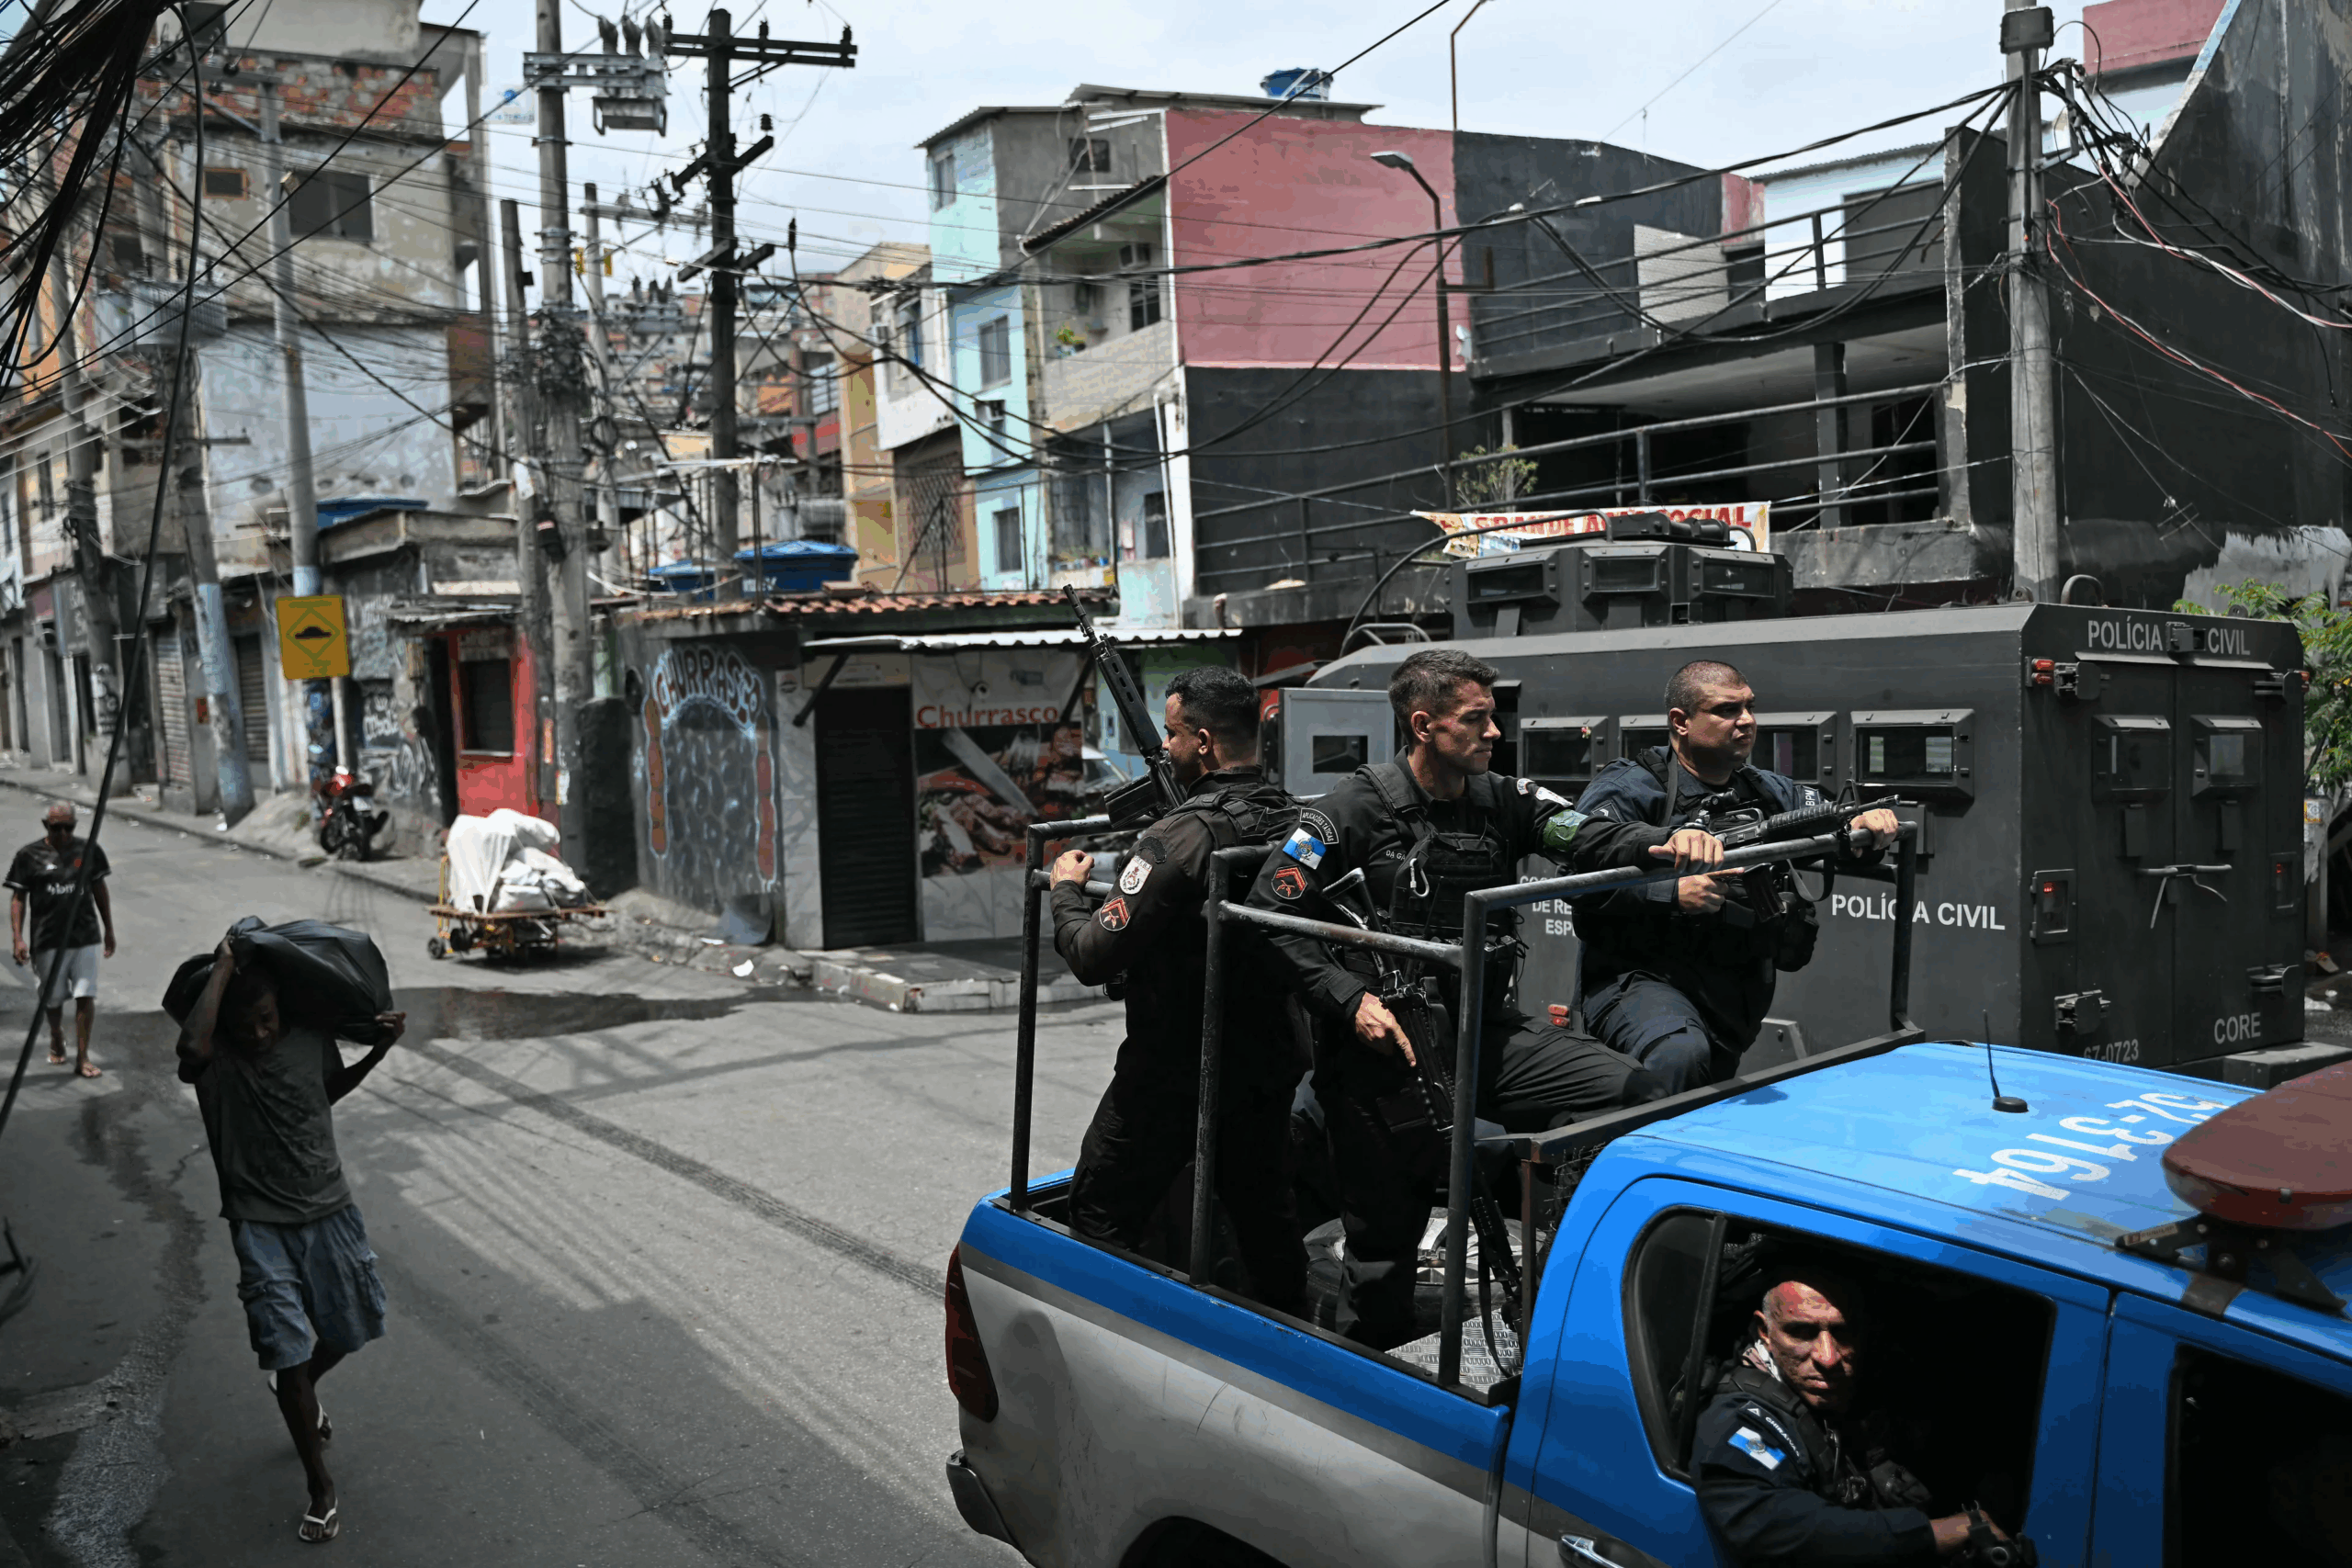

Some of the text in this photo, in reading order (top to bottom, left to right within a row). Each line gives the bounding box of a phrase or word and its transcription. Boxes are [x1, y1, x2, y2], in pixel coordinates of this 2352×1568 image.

[2087, 615, 2251, 656] POLÍCIA CIVIL
[917, 705, 1058, 728] Churrasco
[1804, 789, 1815, 807] BPM
[1832, 892, 2006, 931] POLÍCA CIVIL
[1545, 919, 1577, 937] ESP
[2214, 1011, 2262, 1045] CORE
